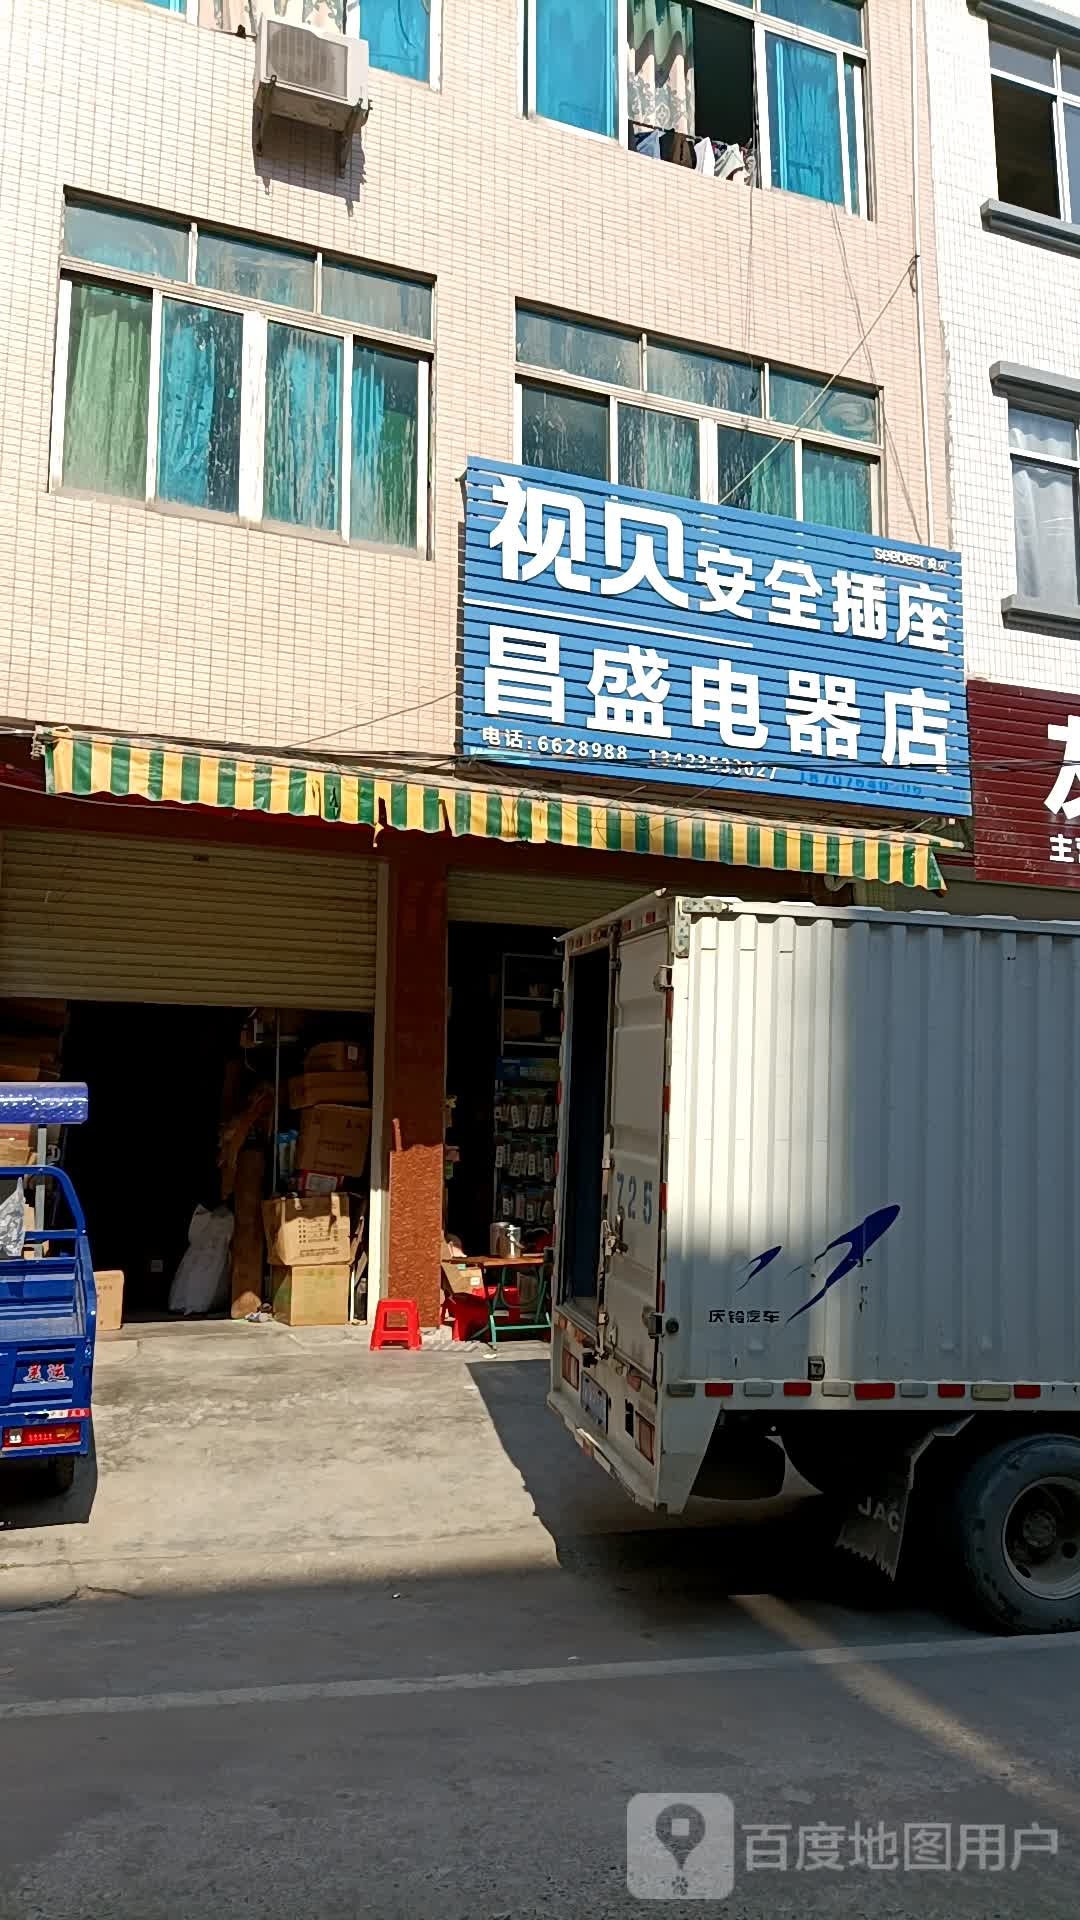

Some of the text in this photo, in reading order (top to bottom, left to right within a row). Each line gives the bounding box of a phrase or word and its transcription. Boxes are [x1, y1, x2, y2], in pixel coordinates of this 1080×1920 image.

[483, 624, 952, 773] 昌盛电器店
[616, 1171, 653, 1225] 725
[857, 1495, 901, 1532] JAC
